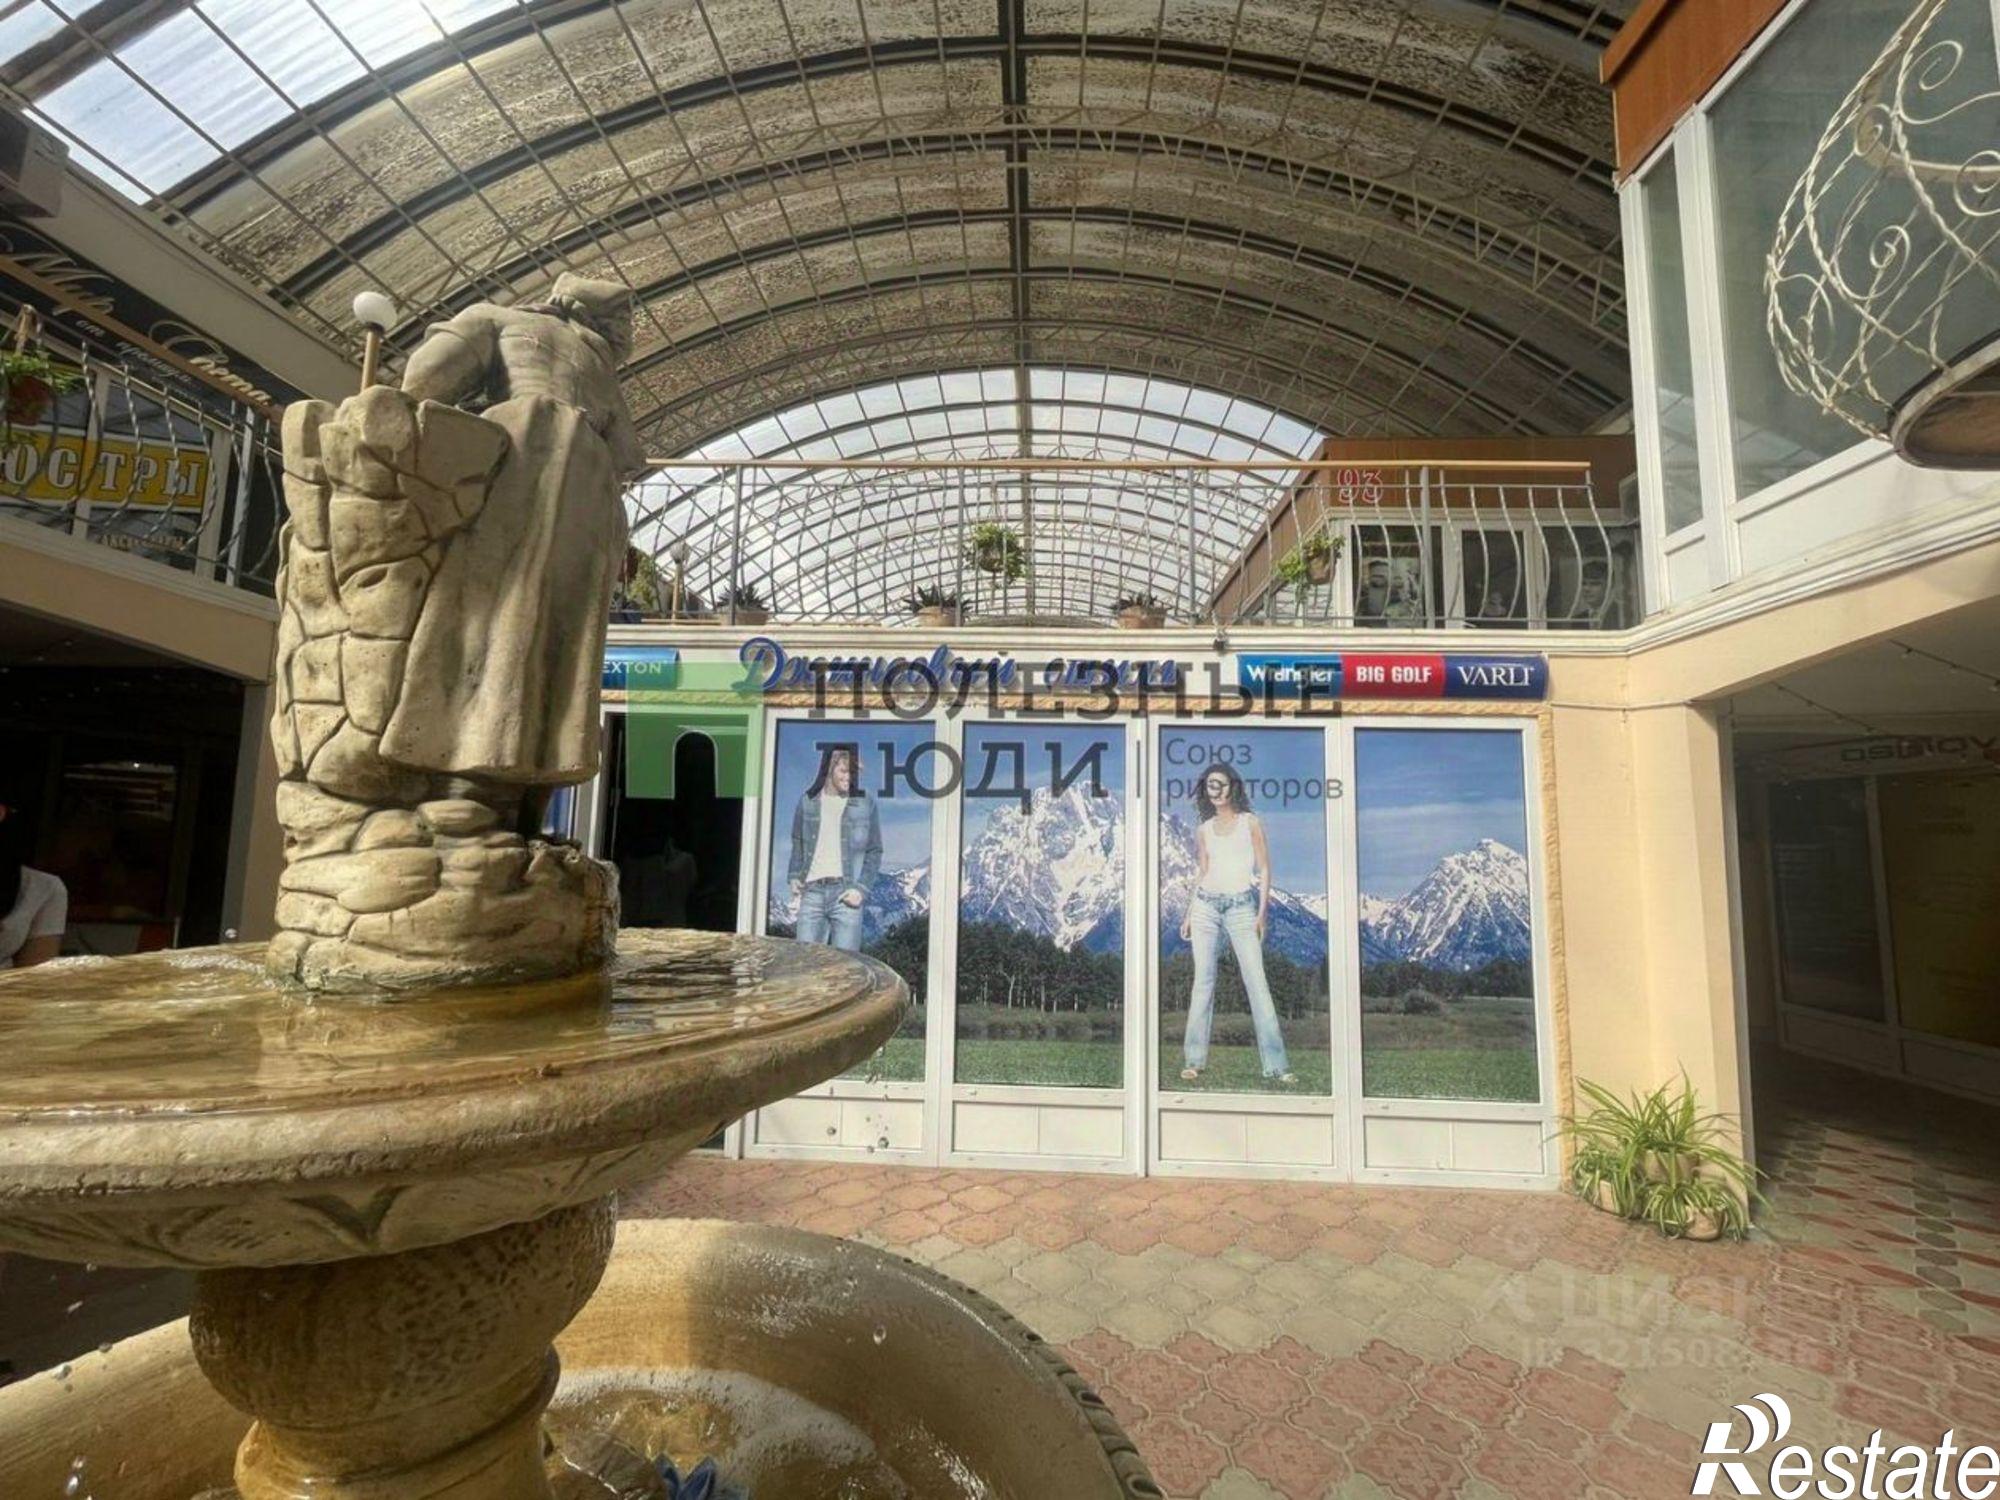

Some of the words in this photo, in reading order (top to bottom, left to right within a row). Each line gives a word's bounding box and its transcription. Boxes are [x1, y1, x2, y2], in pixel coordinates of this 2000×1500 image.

[0, 442, 202, 497] ЮСТРЫ
[1337, 467, 1384, 504] 93
[602, 661, 661, 674] EXTON
[1246, 664, 1334, 688] Wrangler
[1356, 666, 1384, 683] BIG
[1391, 666, 1432, 684] GOLF
